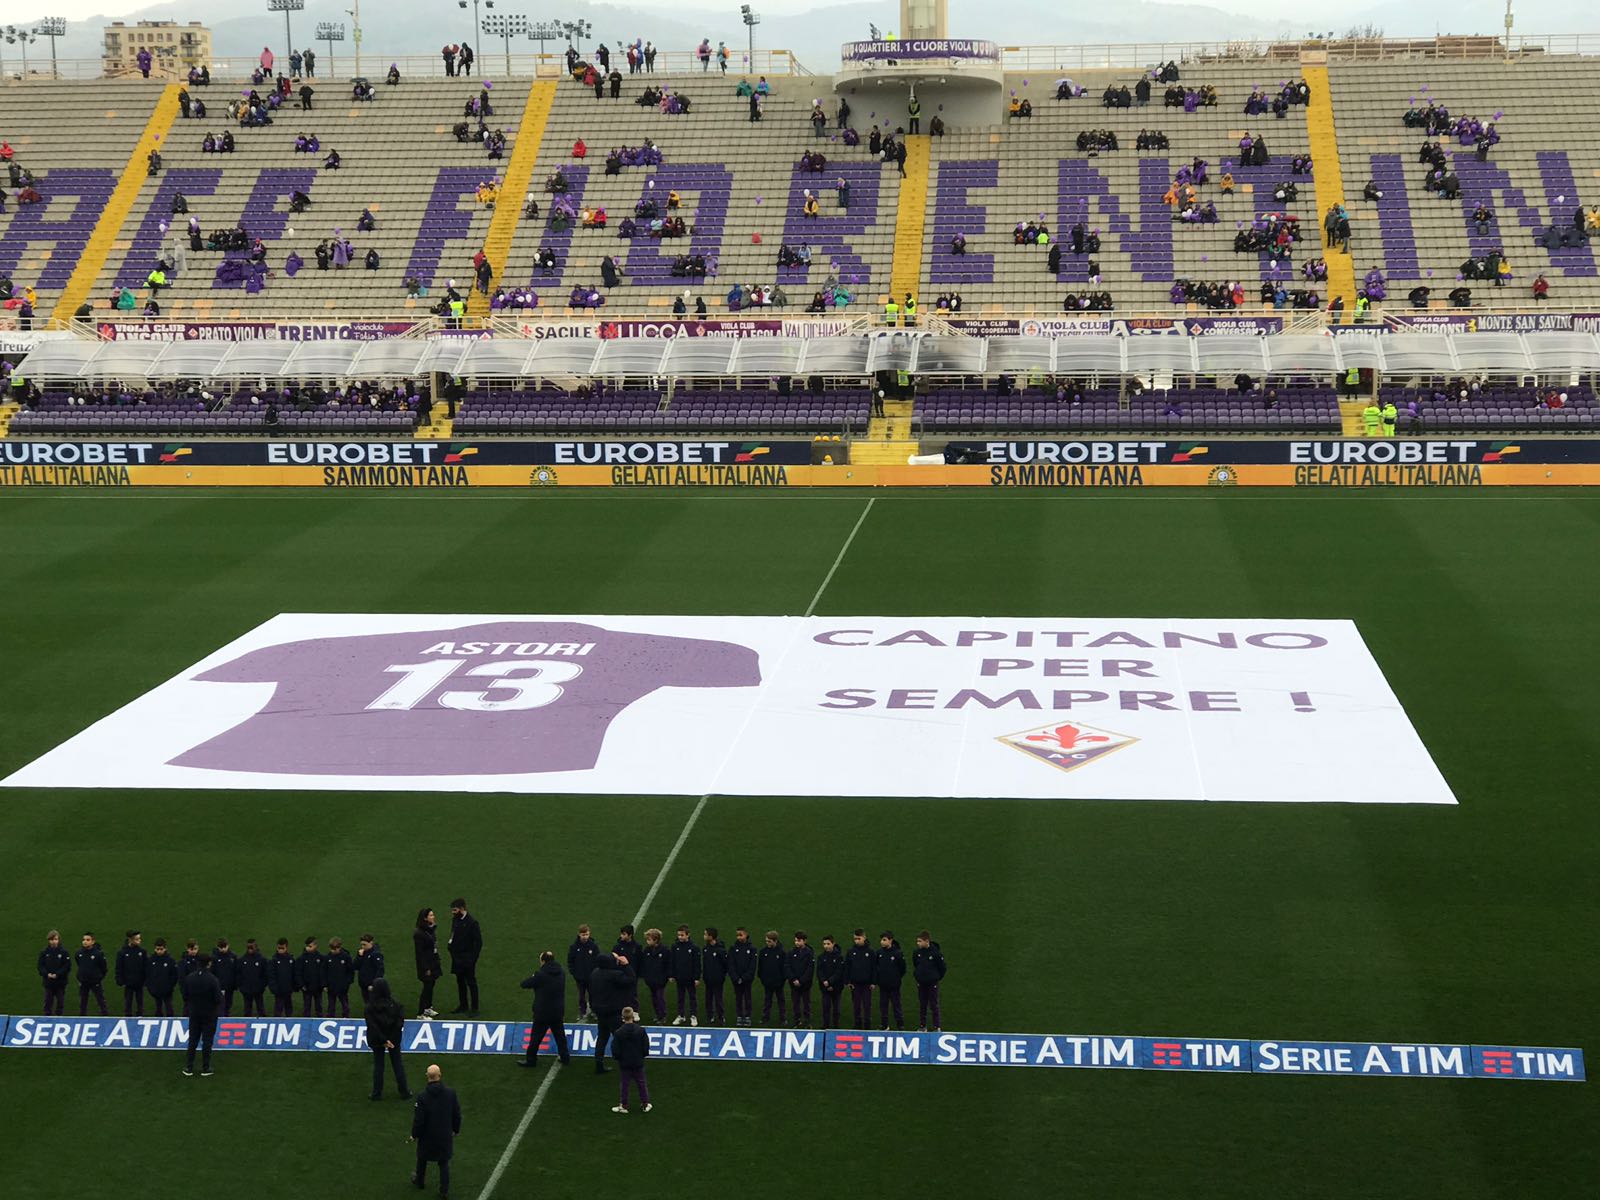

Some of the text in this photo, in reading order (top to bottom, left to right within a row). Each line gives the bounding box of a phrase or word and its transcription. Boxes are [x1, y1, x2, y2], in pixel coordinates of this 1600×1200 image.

[905, 43, 911, 51] 1
[912, 41, 948, 51] CUORE
[950, 41, 972, 51] VIOLA
[114, 324, 186, 333] VIOLA CLUB
[200, 326, 266, 341] PRATO VIOLA
[278, 325, 352, 341] TRENTO
[534, 326, 592, 339] SACILE
[618, 323, 689, 338] LUCCA
[720, 322, 755, 330] VIOLA CLUB
[1042, 321, 1109, 330] VIOLA CLUB
[1128, 319, 1172, 328] VIOLA CLUB
[1477, 316, 1513, 330] MONTE
[1515, 316, 1536, 330] SAN
[0, 443, 152, 463] UROBET
[268, 443, 438, 463] EUROBET
[555, 442, 729, 463] EUROBET
[986, 442, 1167, 463] EUROBET
[1290, 441, 1477, 463] EUROBET
[324, 466, 469, 486] SAMMONTANA
[611, 465, 788, 486] GELATI ALL'ITALIANA
[990, 465, 1143, 486] SAMMONTANA
[1294, 465, 1482, 486] GELATI ALL'ITALIANA
[419, 641, 597, 656] ASTORI
[812, 629, 1329, 650] CAPITANO
[979, 658, 1161, 678] PER
[364, 659, 584, 711] 13
[817, 688, 1317, 713] SEMPRE !
[10, 1018, 190, 1047] SERIE A TIM
[250, 1023, 301, 1045] TIM
[314, 1020, 506, 1051] SER A TIM
[648, 1031, 816, 1059] ERIE A TIM
[867, 1036, 920, 1059] TIM
[937, 1034, 1135, 1066] SERIE A TIM
[1185, 1044, 1241, 1067] TIM
[1258, 1042, 1465, 1075] SERIE A TIM
[1516, 1052, 1575, 1076] TIM
